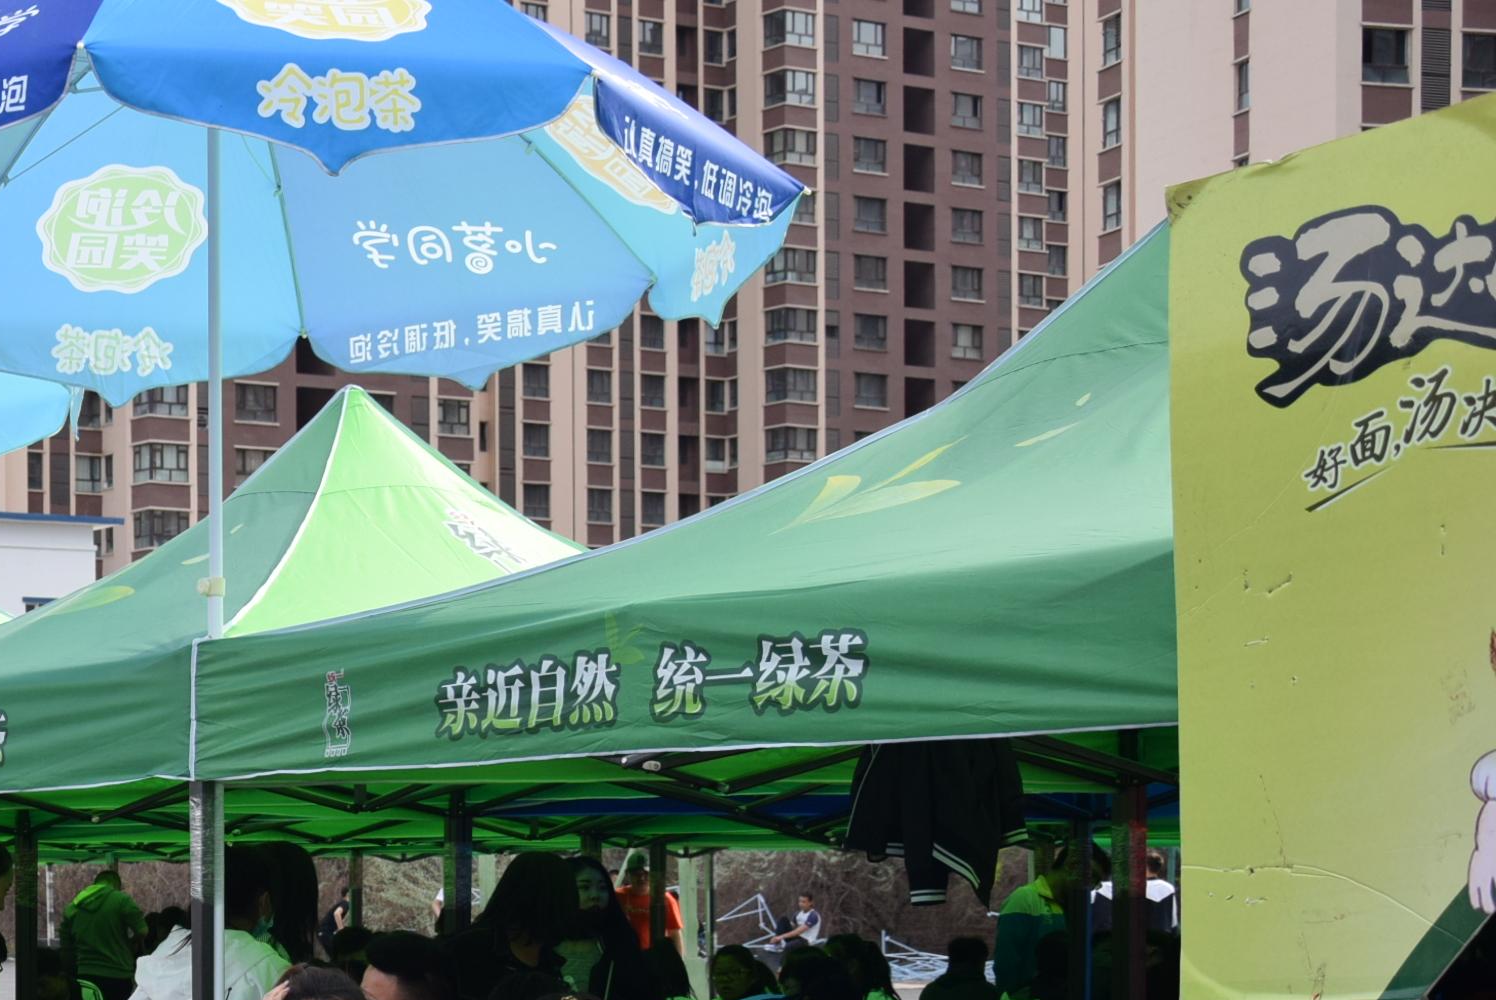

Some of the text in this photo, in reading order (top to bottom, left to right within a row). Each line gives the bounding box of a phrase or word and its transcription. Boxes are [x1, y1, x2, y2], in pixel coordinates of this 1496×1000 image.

[257, 63, 421, 132] 冷泡茶
[1247, 213, 1496, 398] 汤达
[440, 632, 869, 738] 亲近自然 统一绿茶
